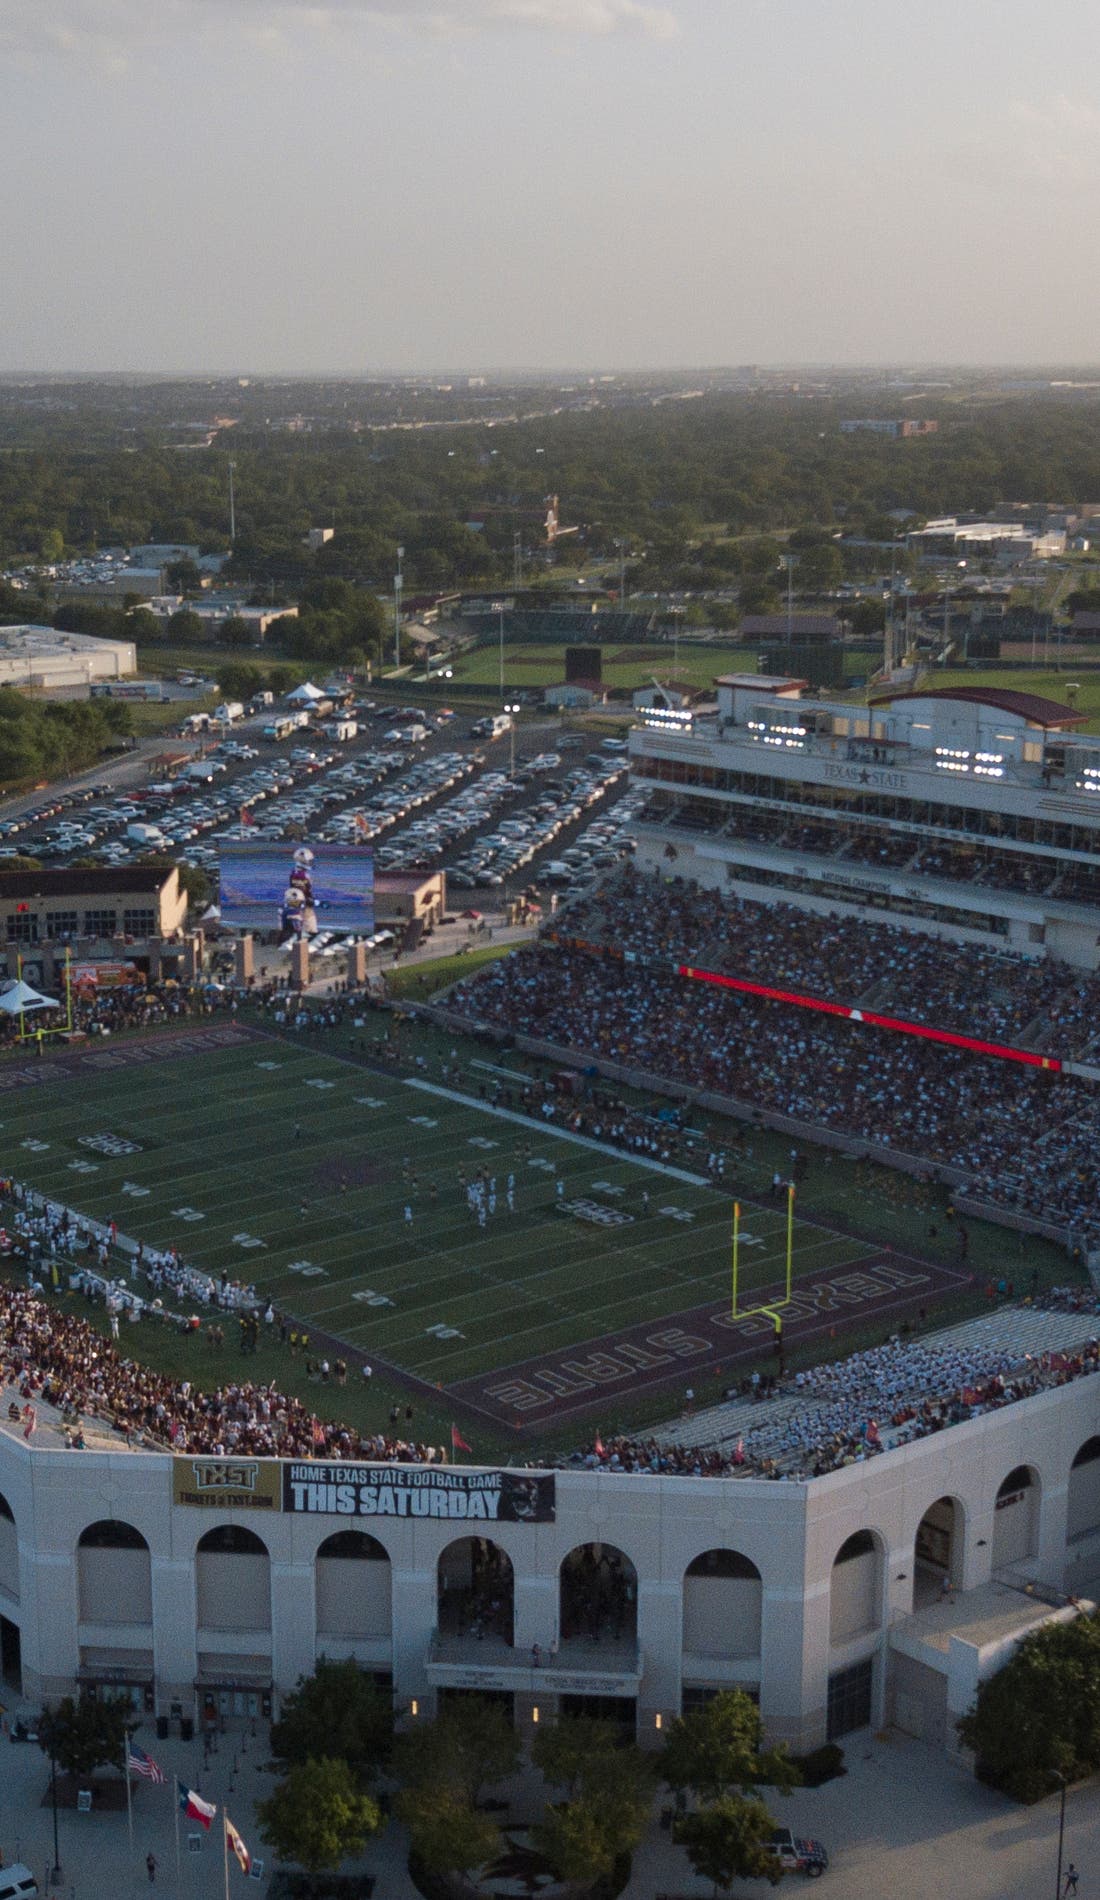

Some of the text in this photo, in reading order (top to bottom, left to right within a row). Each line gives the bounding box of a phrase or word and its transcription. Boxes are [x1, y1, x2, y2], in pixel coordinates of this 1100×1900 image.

[824, 764, 907, 787] TEXAS STATE
[484, 1265, 930, 1411] TEXAS STATE
[196, 1464, 256, 1488] TXST
[291, 1466, 502, 1489] HOME TEXAS STATE FOOTBALL GAME
[290, 1482, 501, 1519] THIS SATURDAY
